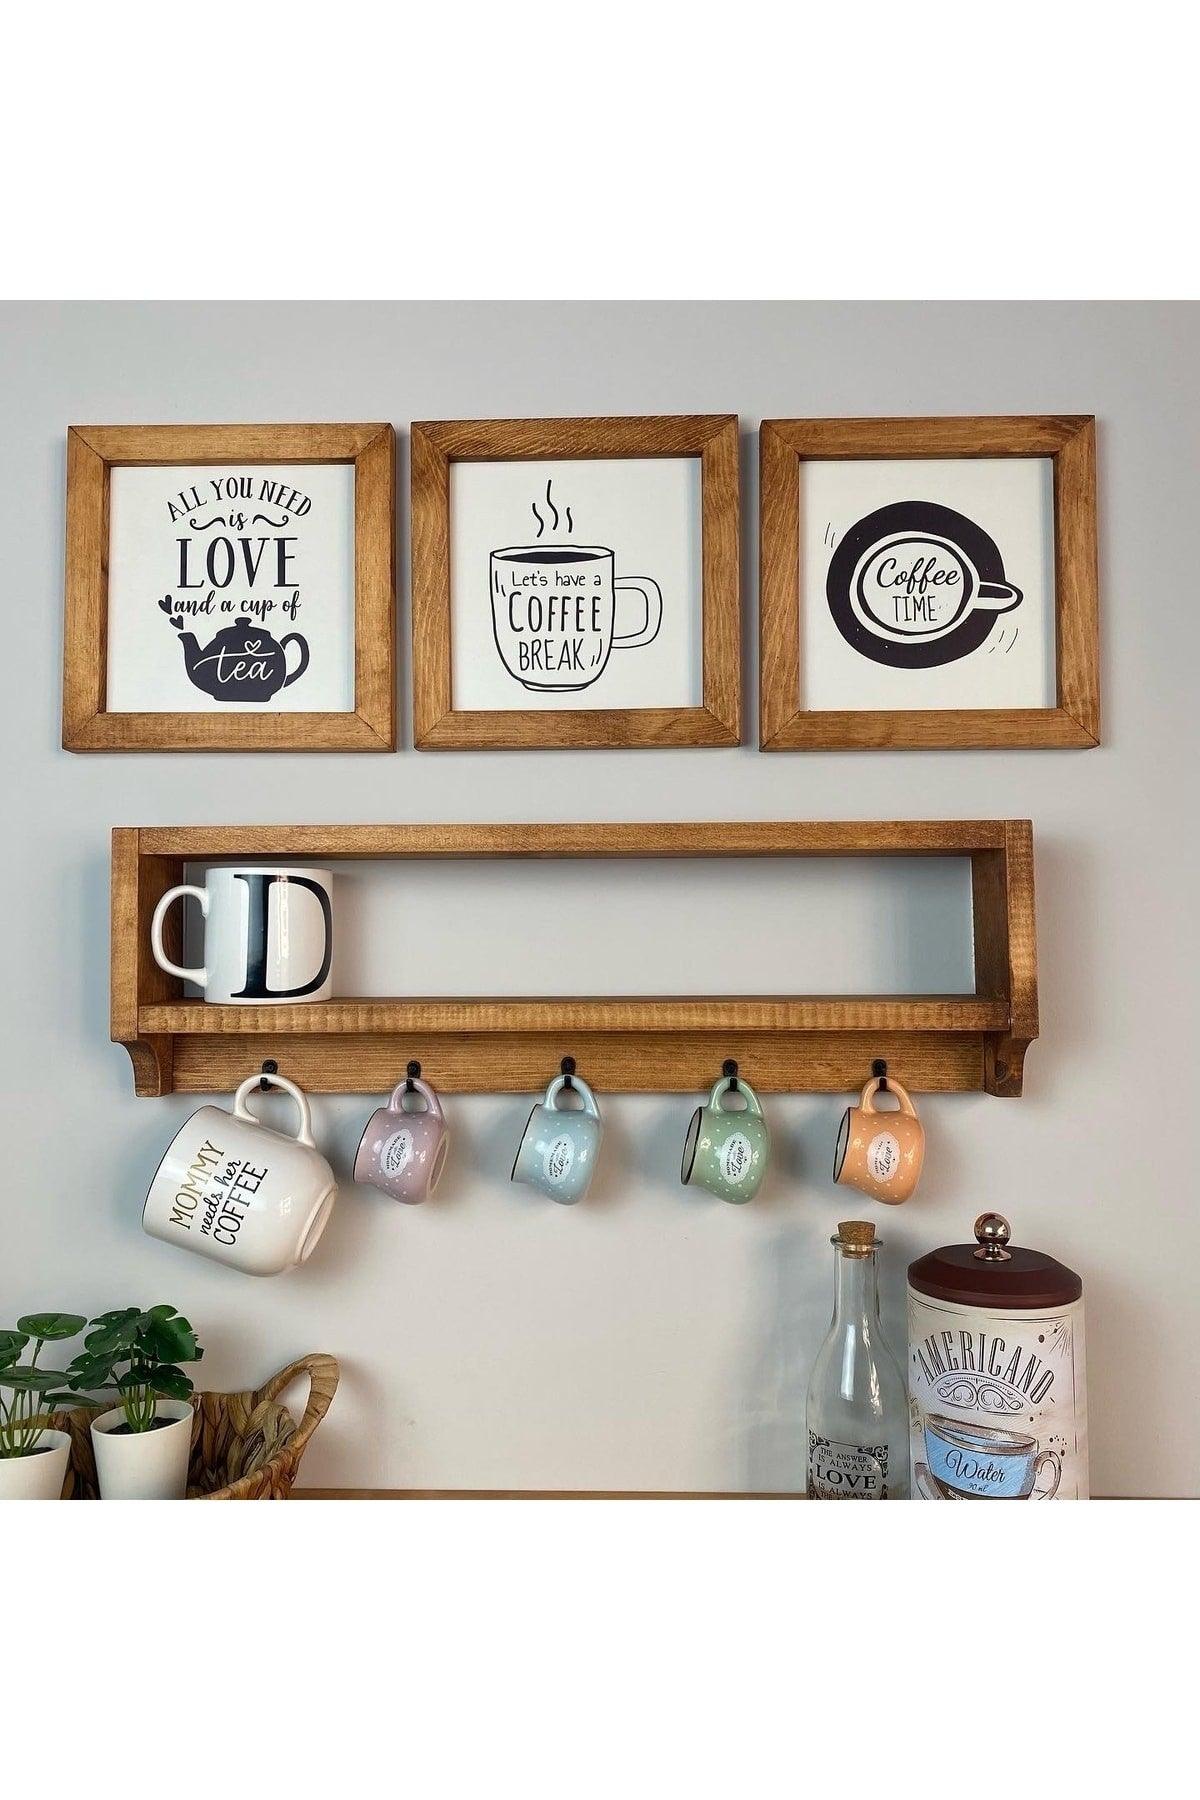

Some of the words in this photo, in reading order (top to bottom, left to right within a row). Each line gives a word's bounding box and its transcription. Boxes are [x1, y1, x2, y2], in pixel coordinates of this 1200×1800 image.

[167, 486, 207, 523] ALL
[210, 477, 252, 501] YOU
[258, 480, 312, 518] NEED
[229, 509, 248, 531] is
[176, 536, 300, 588] LOVE
[512, 570, 548, 587] Let's
[555, 570, 586, 587] have
[594, 574, 602, 586] a
[876, 557, 961, 595] Coffee
[174, 590, 215, 615] and
[221, 601, 236, 613] a
[240, 601, 276, 621] cup
[282, 591, 302, 621] of
[508, 591, 602, 633] COFFEE
[892, 595, 938, 623] TIME
[193, 648, 275, 684] tea
[518, 638, 585, 671] BREAK
[230, 874, 332, 998] D
[732, 1145, 746, 1174] Love
[879, 1146, 893, 1173] Love
[169, 1140, 225, 1230] MOMMY
[200, 1191, 224, 1236] needs
[213, 1159, 242, 1188] her
[213, 1162, 268, 1246] COFFEE
[917, 1331, 1056, 1404] AMERICANO
[818, 1453, 826, 1463] IS
[829, 1459, 873, 1472] ALWAYS
[820, 1447, 833, 1458] THE
[836, 1453, 868, 1464] ANSWER
[945, 1450, 1005, 1483] Water
[816, 1463, 877, 1489] LOVE
[829, 1487, 873, 1500] ALWAYS
